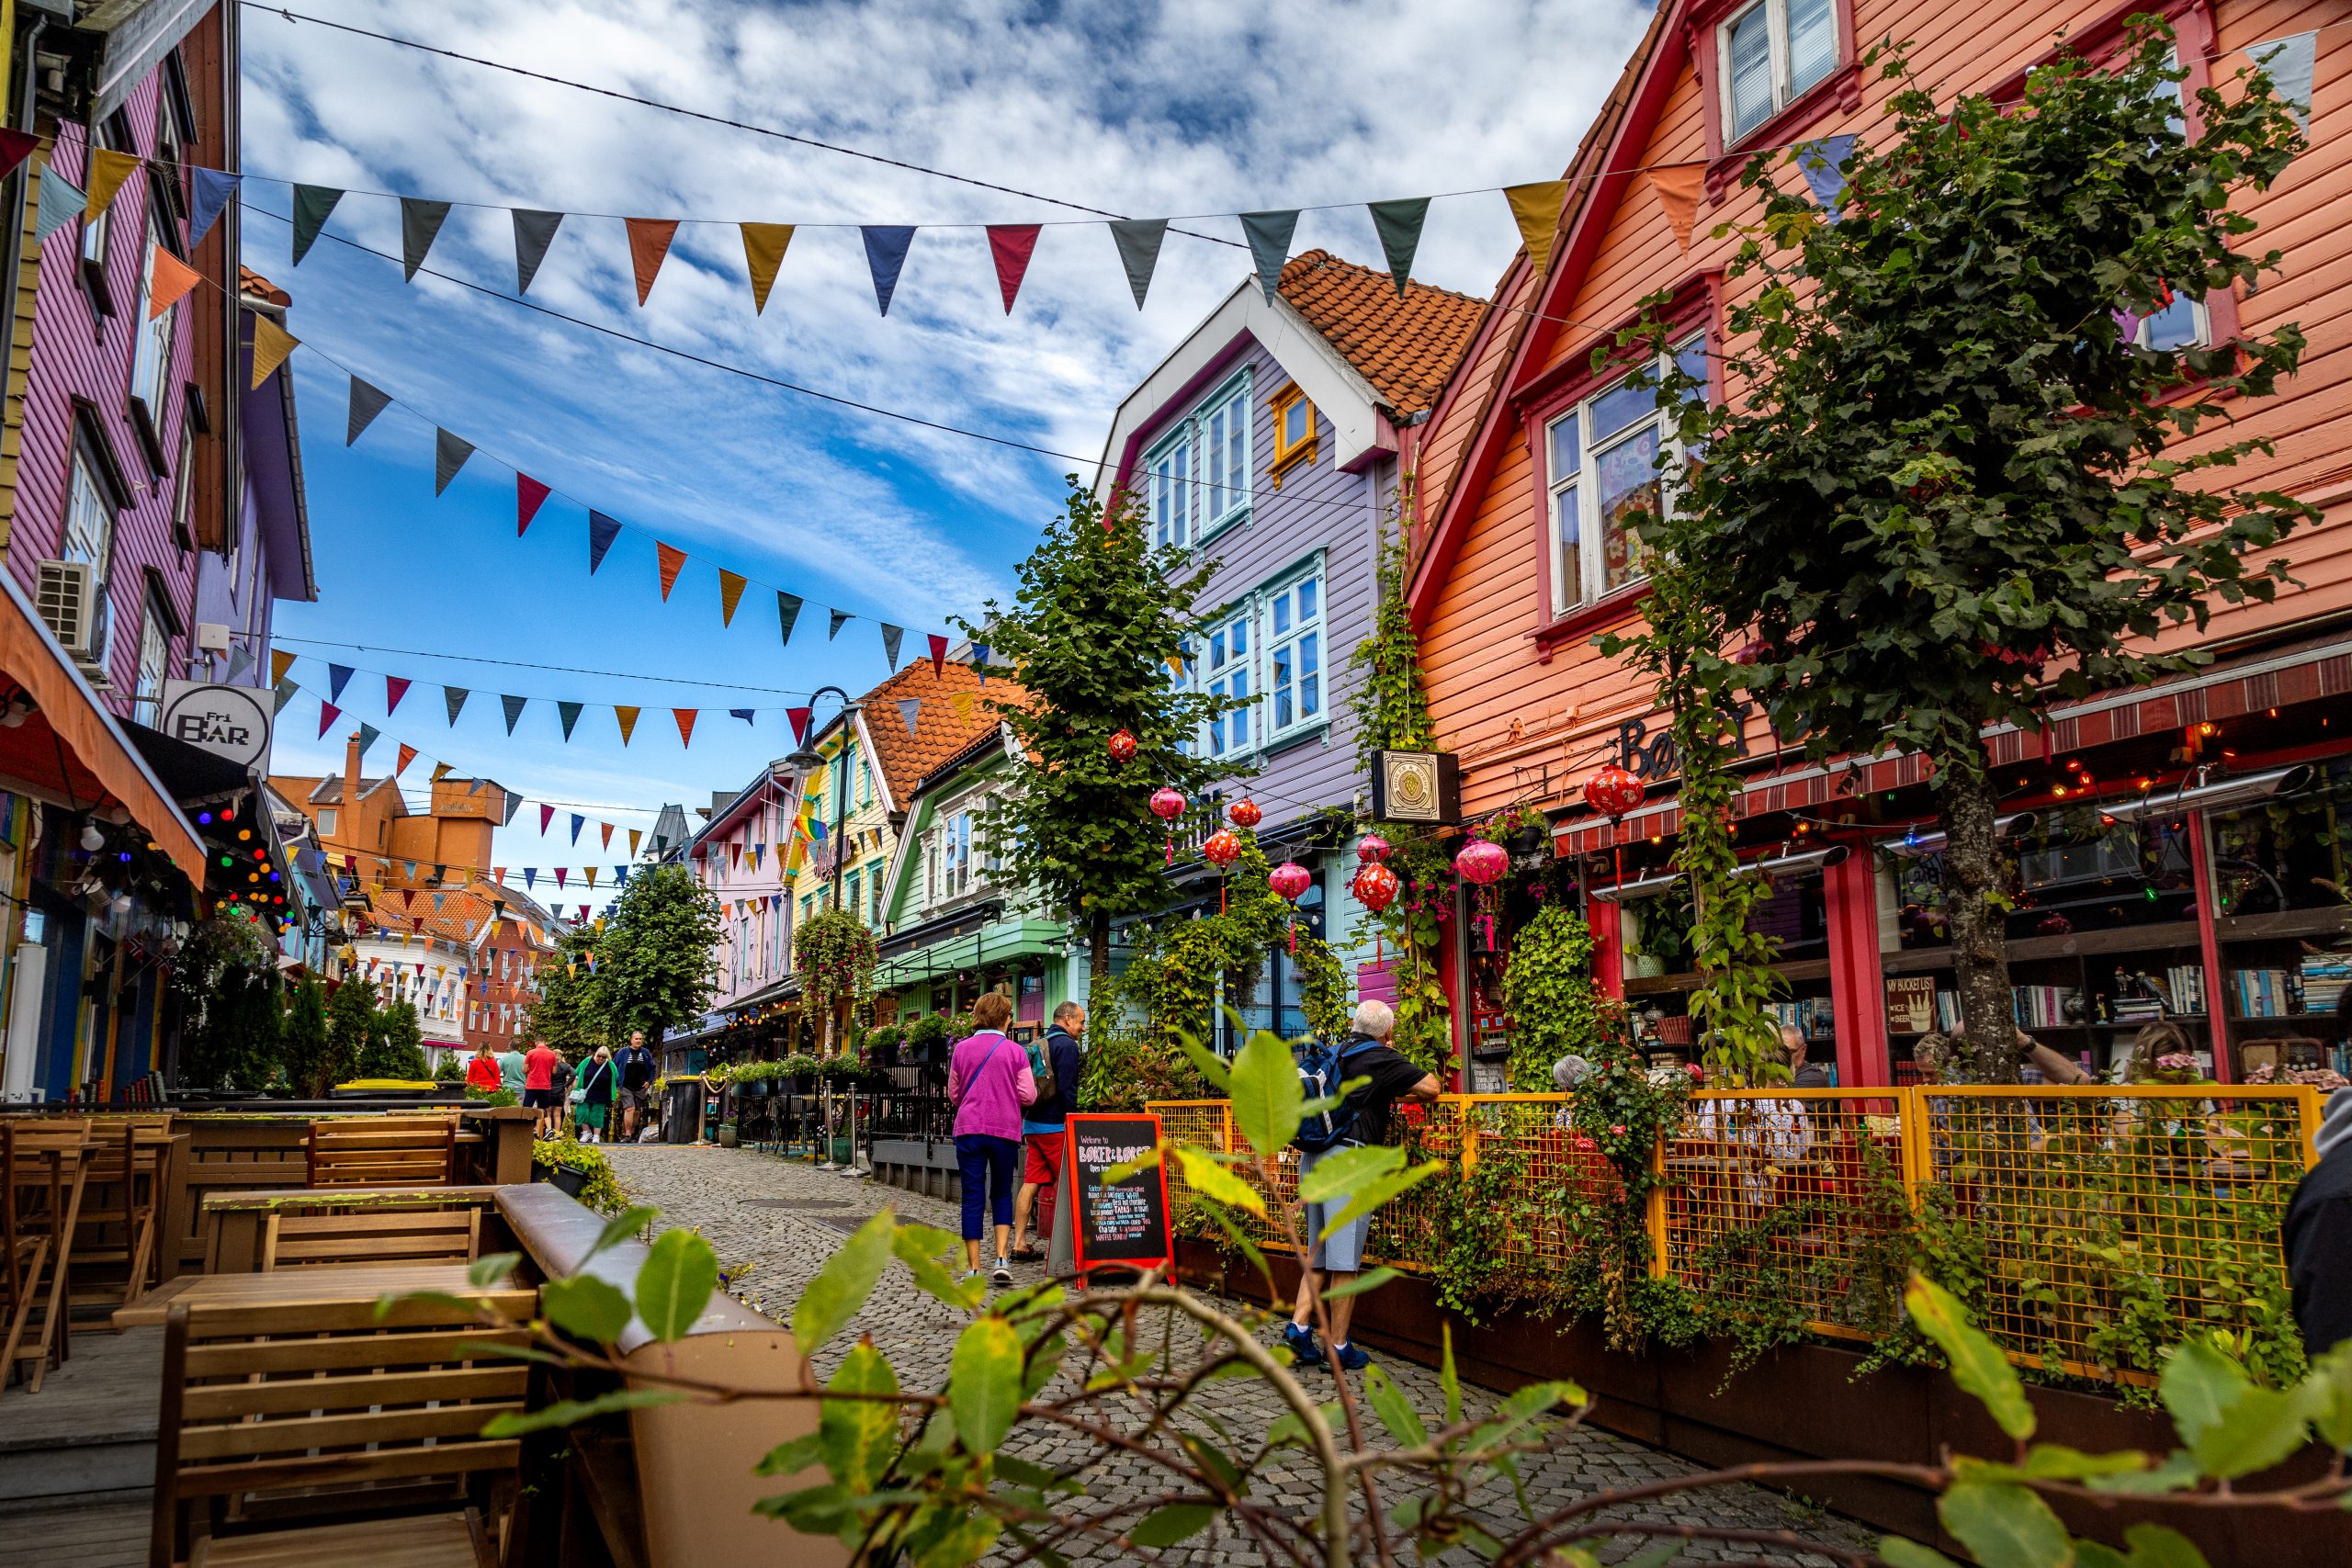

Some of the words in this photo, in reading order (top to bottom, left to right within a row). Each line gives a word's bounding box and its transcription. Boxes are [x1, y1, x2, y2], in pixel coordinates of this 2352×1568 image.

[206, 711, 232, 723] Fri
[175, 714, 249, 746] BAR
[1886, 979, 1897, 992] MY
[1897, 977, 1920, 991] BUCKET
[1920, 976, 1934, 990] LIST
[1894, 1014, 1911, 1022] BEER
[1080, 1134, 1102, 1145] Welcome
[1102, 1135, 1109, 1145] to
[1079, 1145, 1111, 1163] BØKER
[1090, 1164, 1101, 1174] Open
[1114, 1205, 1130, 1213] TAPAS
